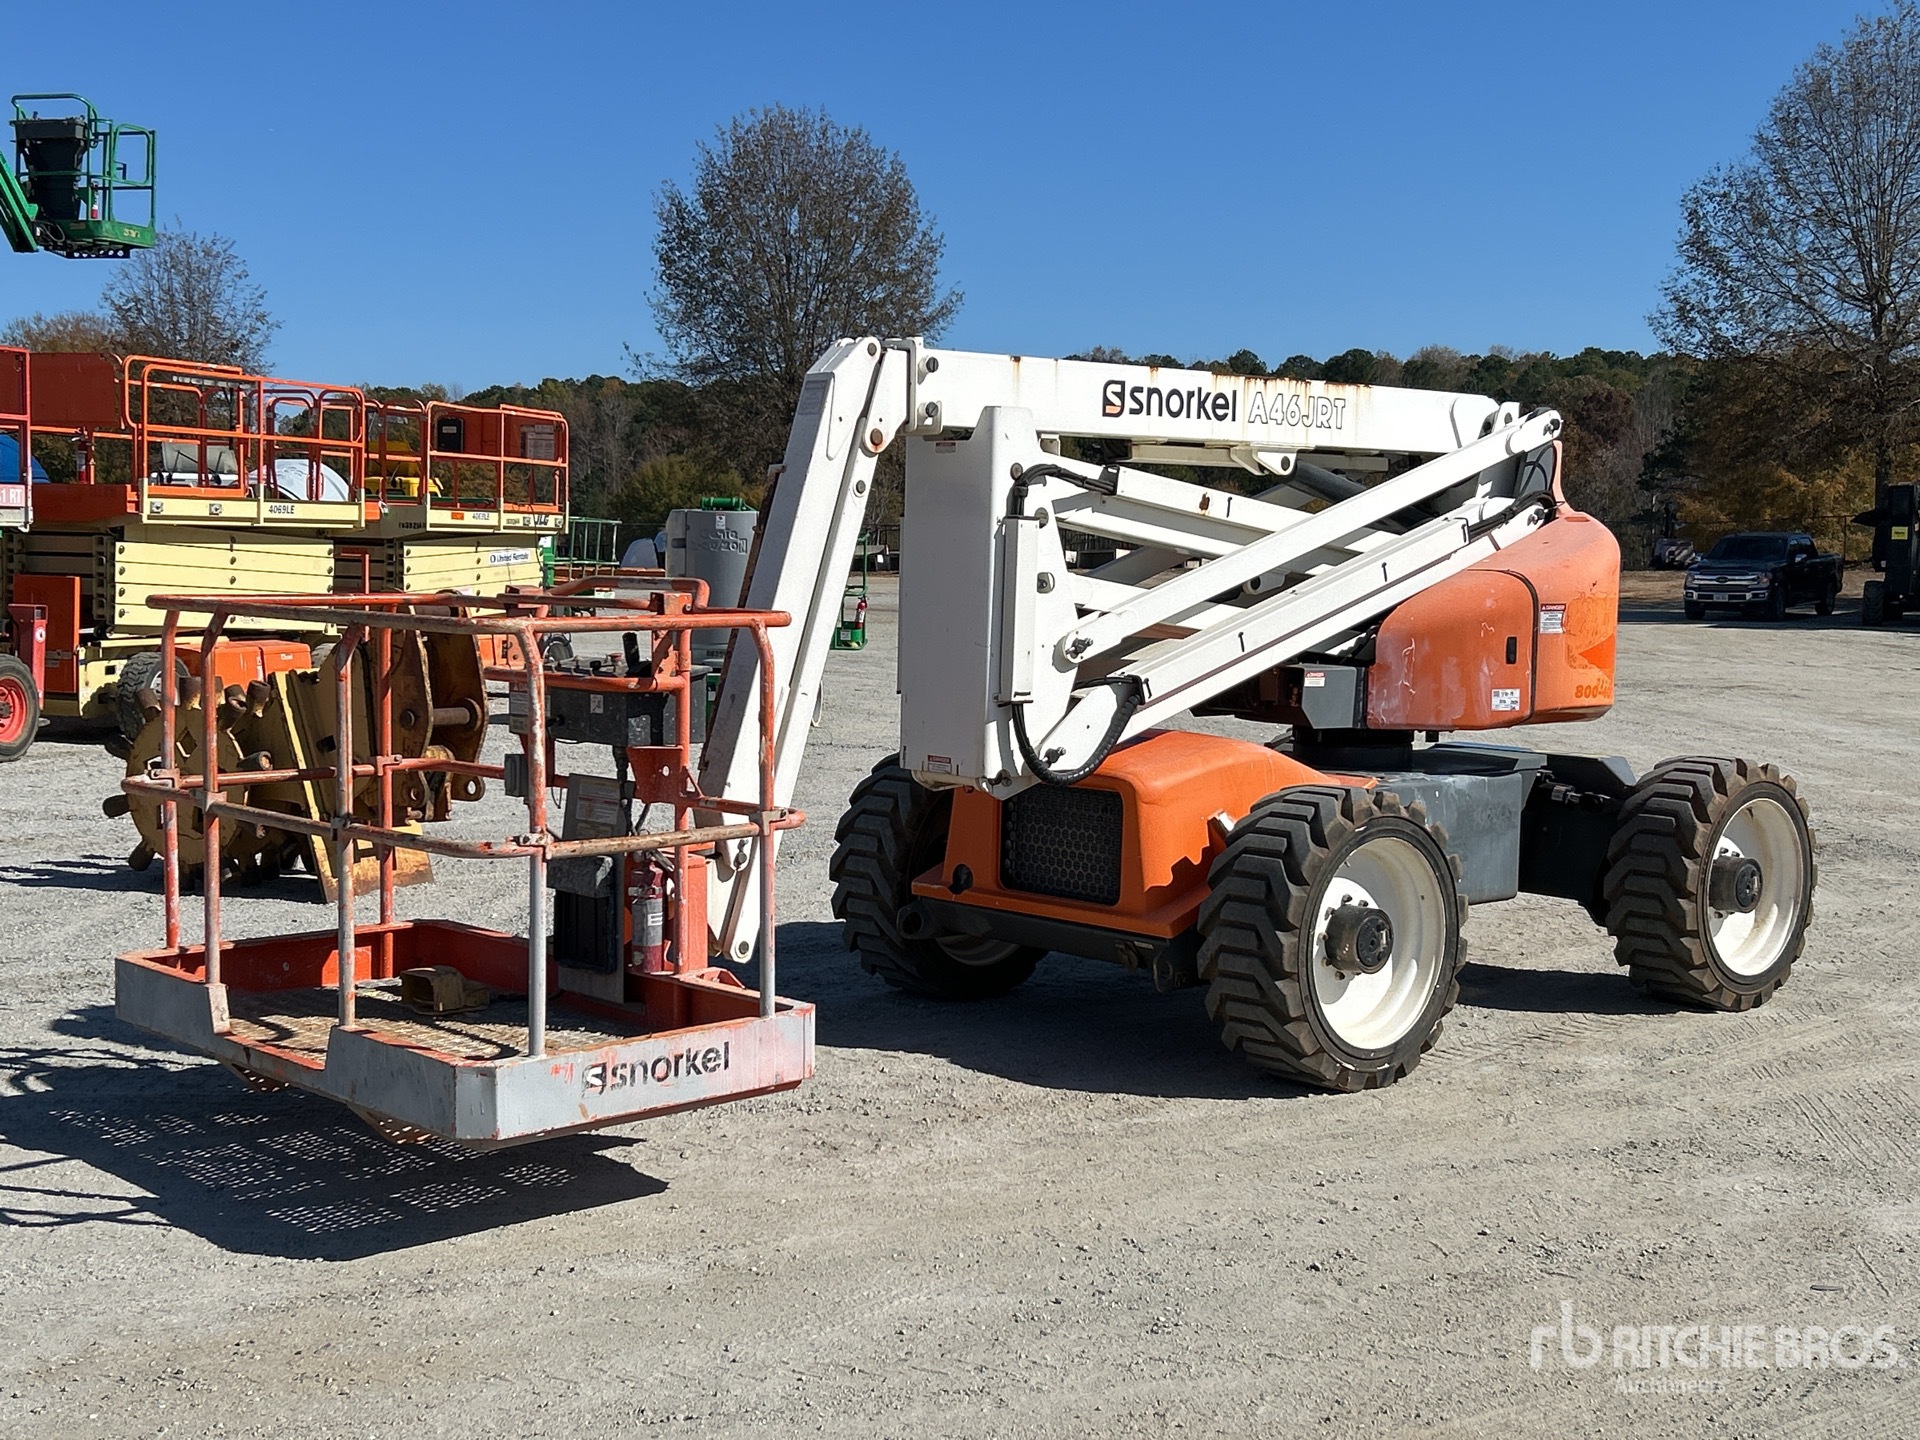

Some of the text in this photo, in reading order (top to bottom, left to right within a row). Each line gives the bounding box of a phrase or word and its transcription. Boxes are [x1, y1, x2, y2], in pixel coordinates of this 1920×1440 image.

[1128, 385, 1237, 422] snorkel
[1248, 391, 1346, 430] A46JRT
[10, 488, 23, 504] RT
[610, 1041, 730, 1090] snorkel
